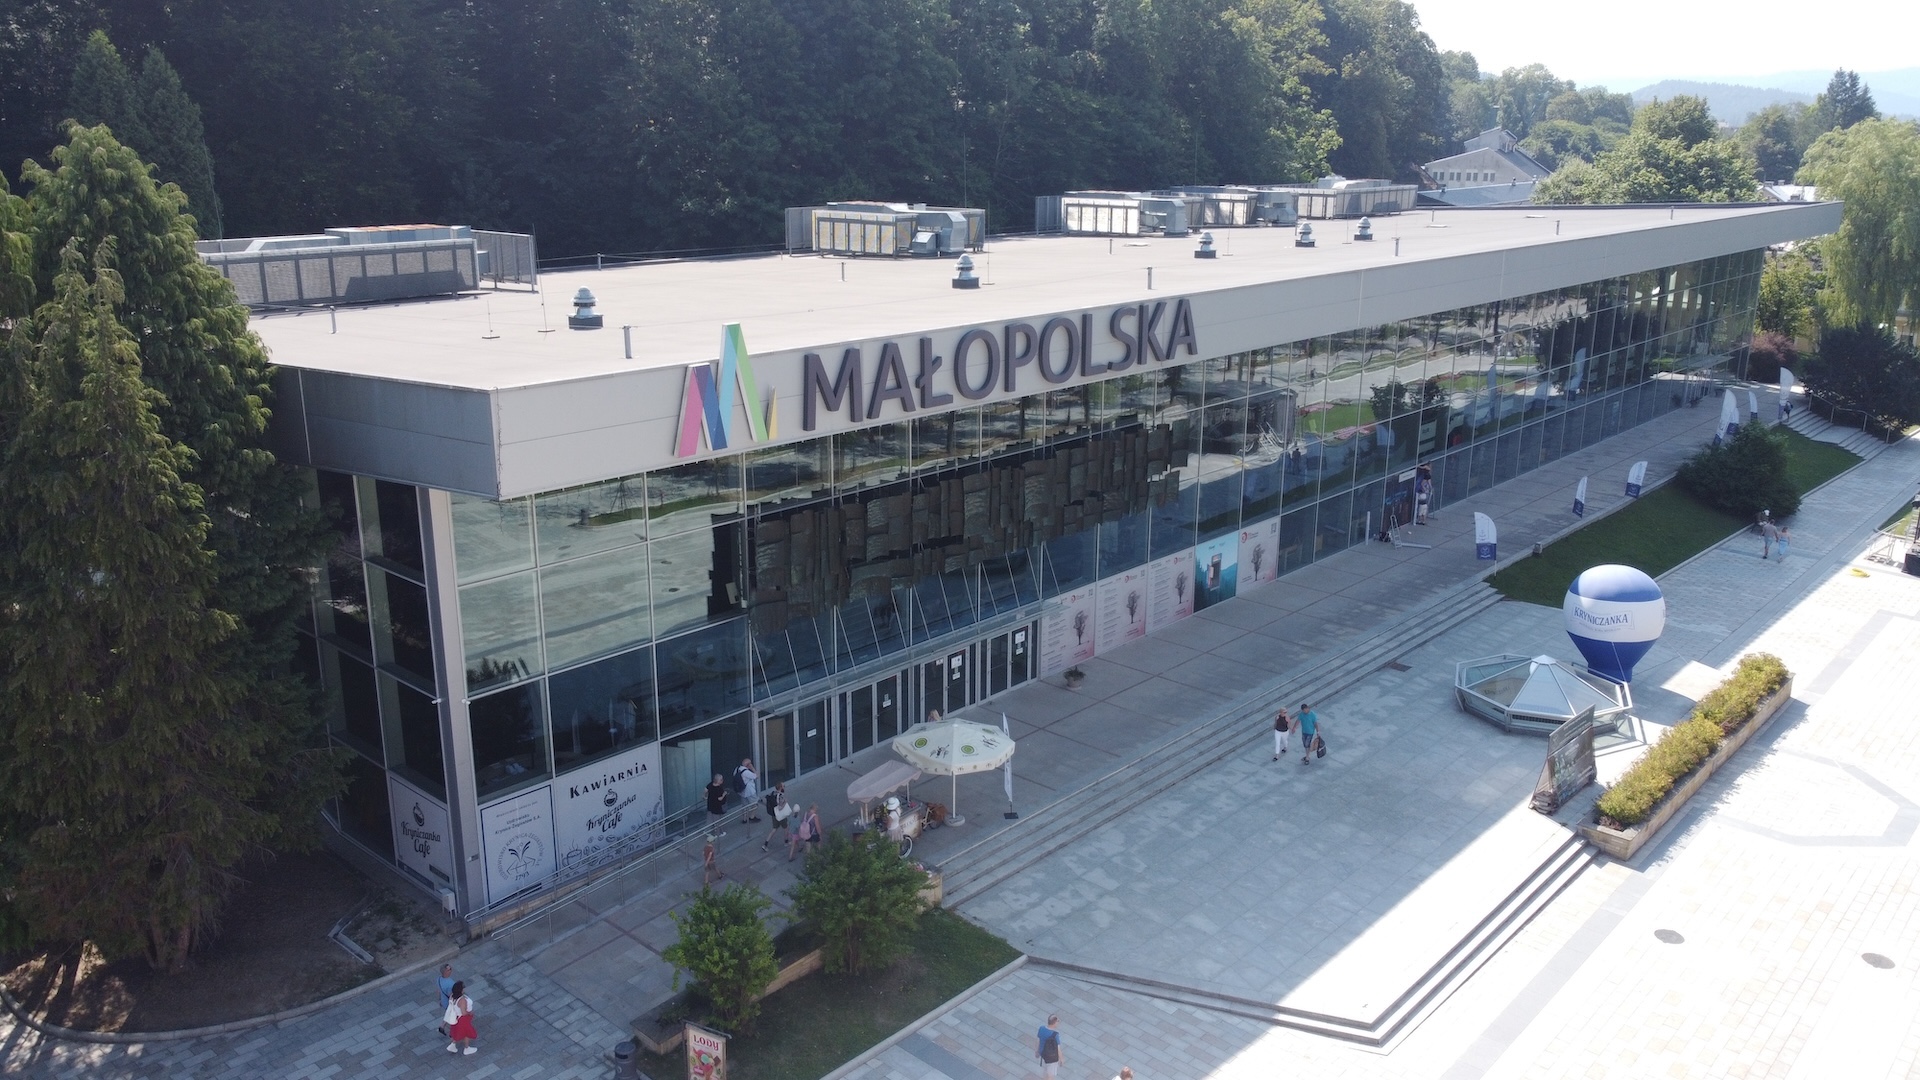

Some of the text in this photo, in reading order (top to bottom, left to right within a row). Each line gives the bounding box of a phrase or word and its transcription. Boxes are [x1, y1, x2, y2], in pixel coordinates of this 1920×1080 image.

[802, 299, 1199, 432] MAŁOPOLSKA
[1573, 606, 1629, 626] KRYNICZANKA
[586, 793, 637, 832] Kryniczanka
[601, 811, 623, 833] Cafe
[400, 820, 441, 843] Kryniczanka
[413, 840, 431, 858] Cafe
[693, 1034, 719, 1051] LODY
